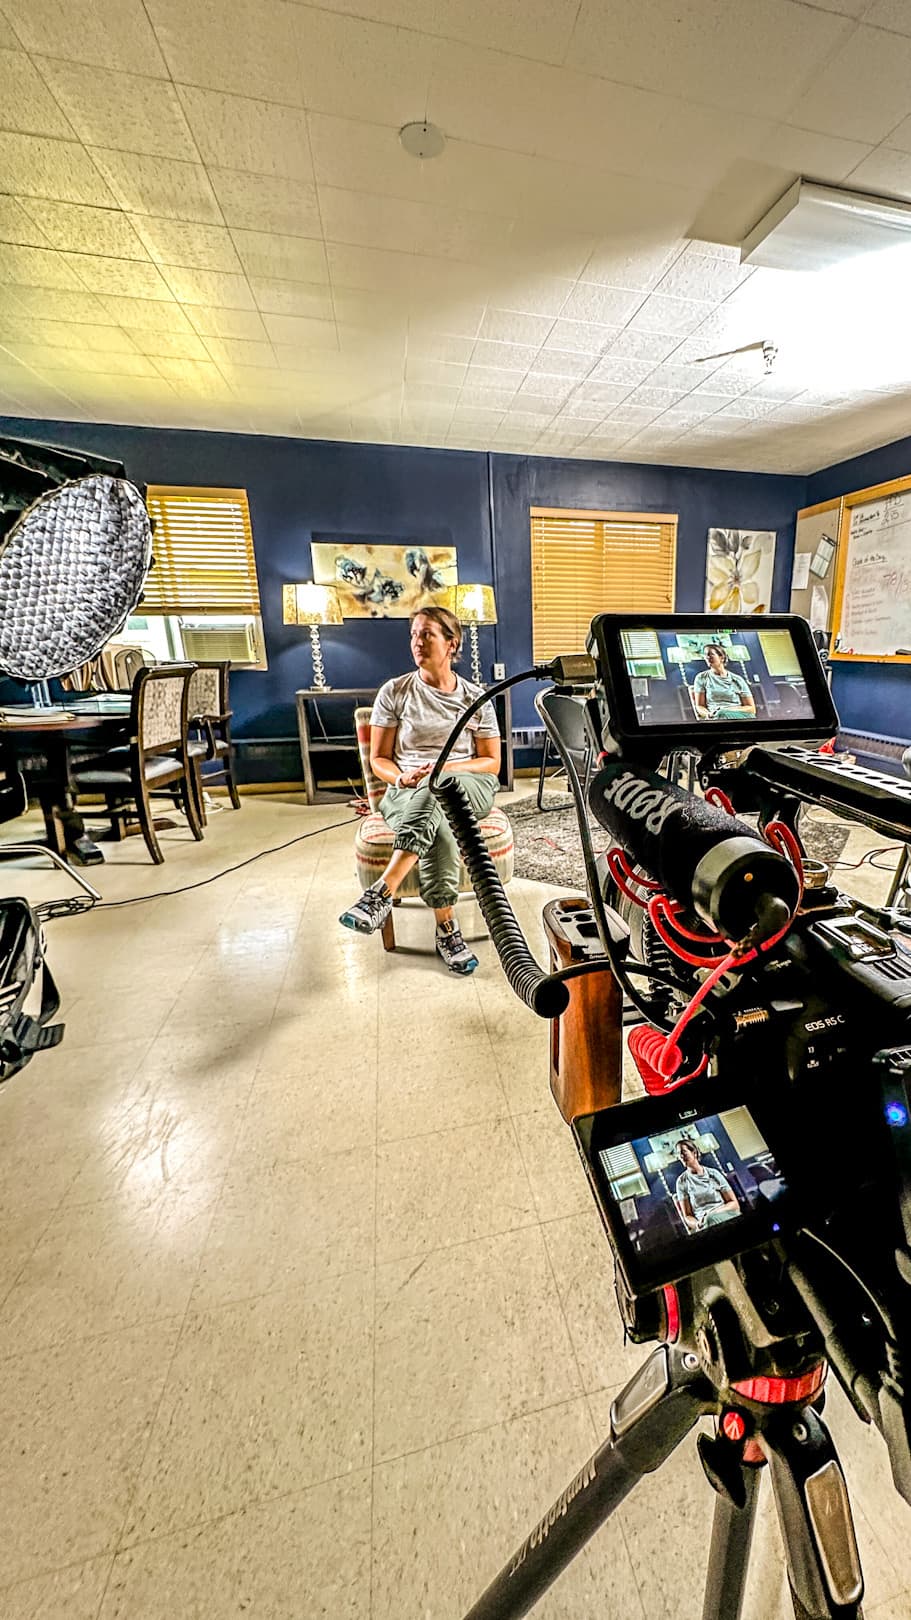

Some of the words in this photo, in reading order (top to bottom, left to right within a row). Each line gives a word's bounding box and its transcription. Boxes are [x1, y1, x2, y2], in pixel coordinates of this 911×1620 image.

[805, 1020, 825, 1031] EOS
[825, 1017, 837, 1026] R5
[837, 1015, 845, 1023] C
